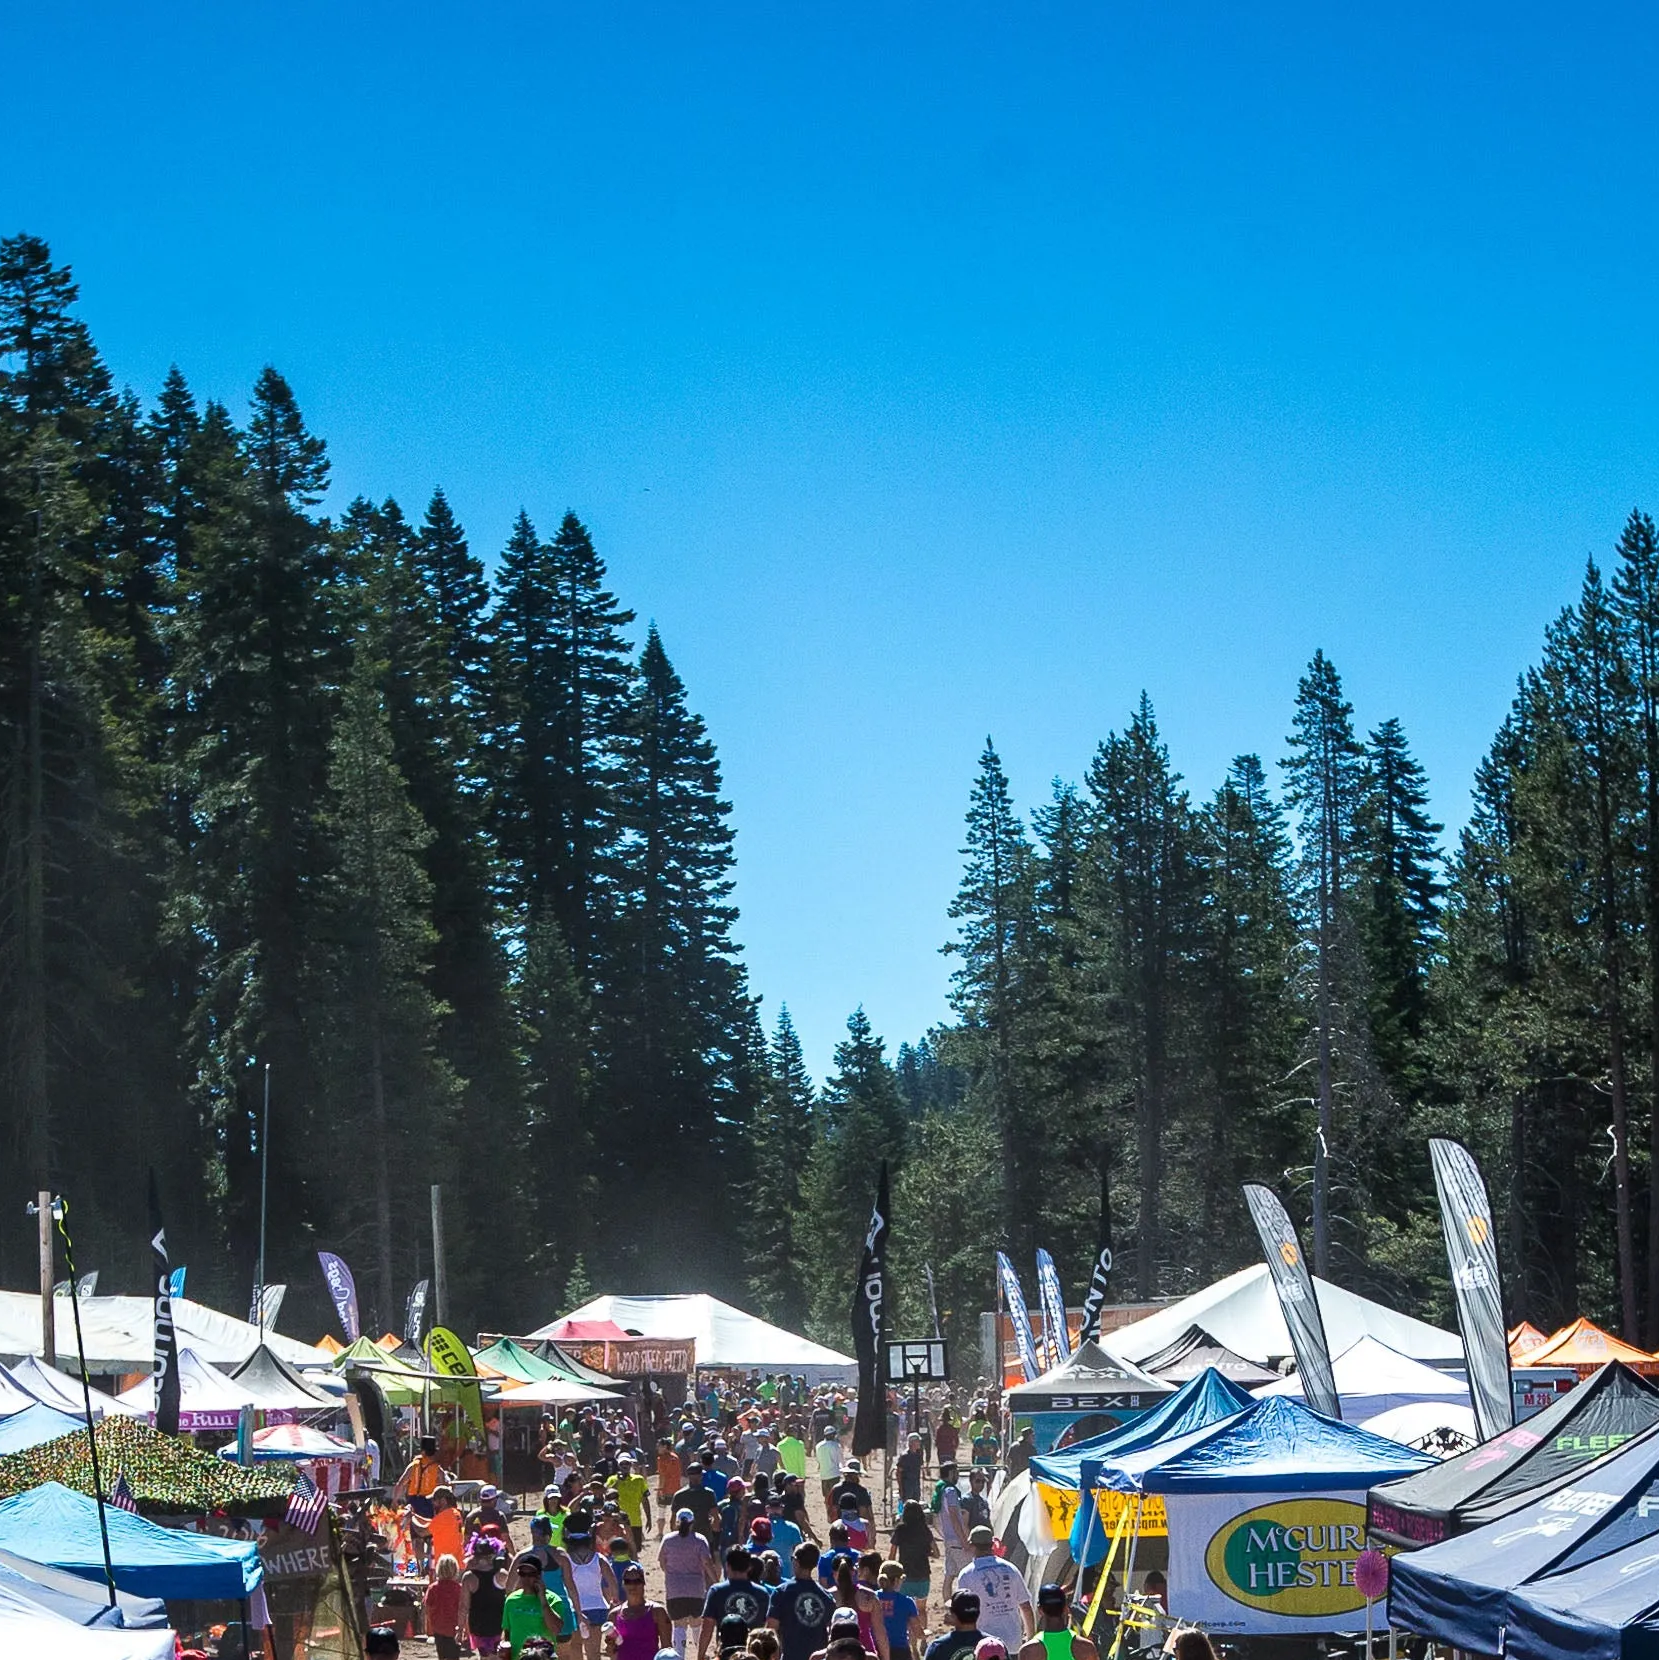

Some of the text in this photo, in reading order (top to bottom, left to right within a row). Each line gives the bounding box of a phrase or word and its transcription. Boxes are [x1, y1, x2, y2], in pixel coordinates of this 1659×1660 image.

[1051, 1396, 1124, 1408] BEX
[191, 1412, 234, 1427] Run
[1248, 1560, 1356, 1588] HESTE
